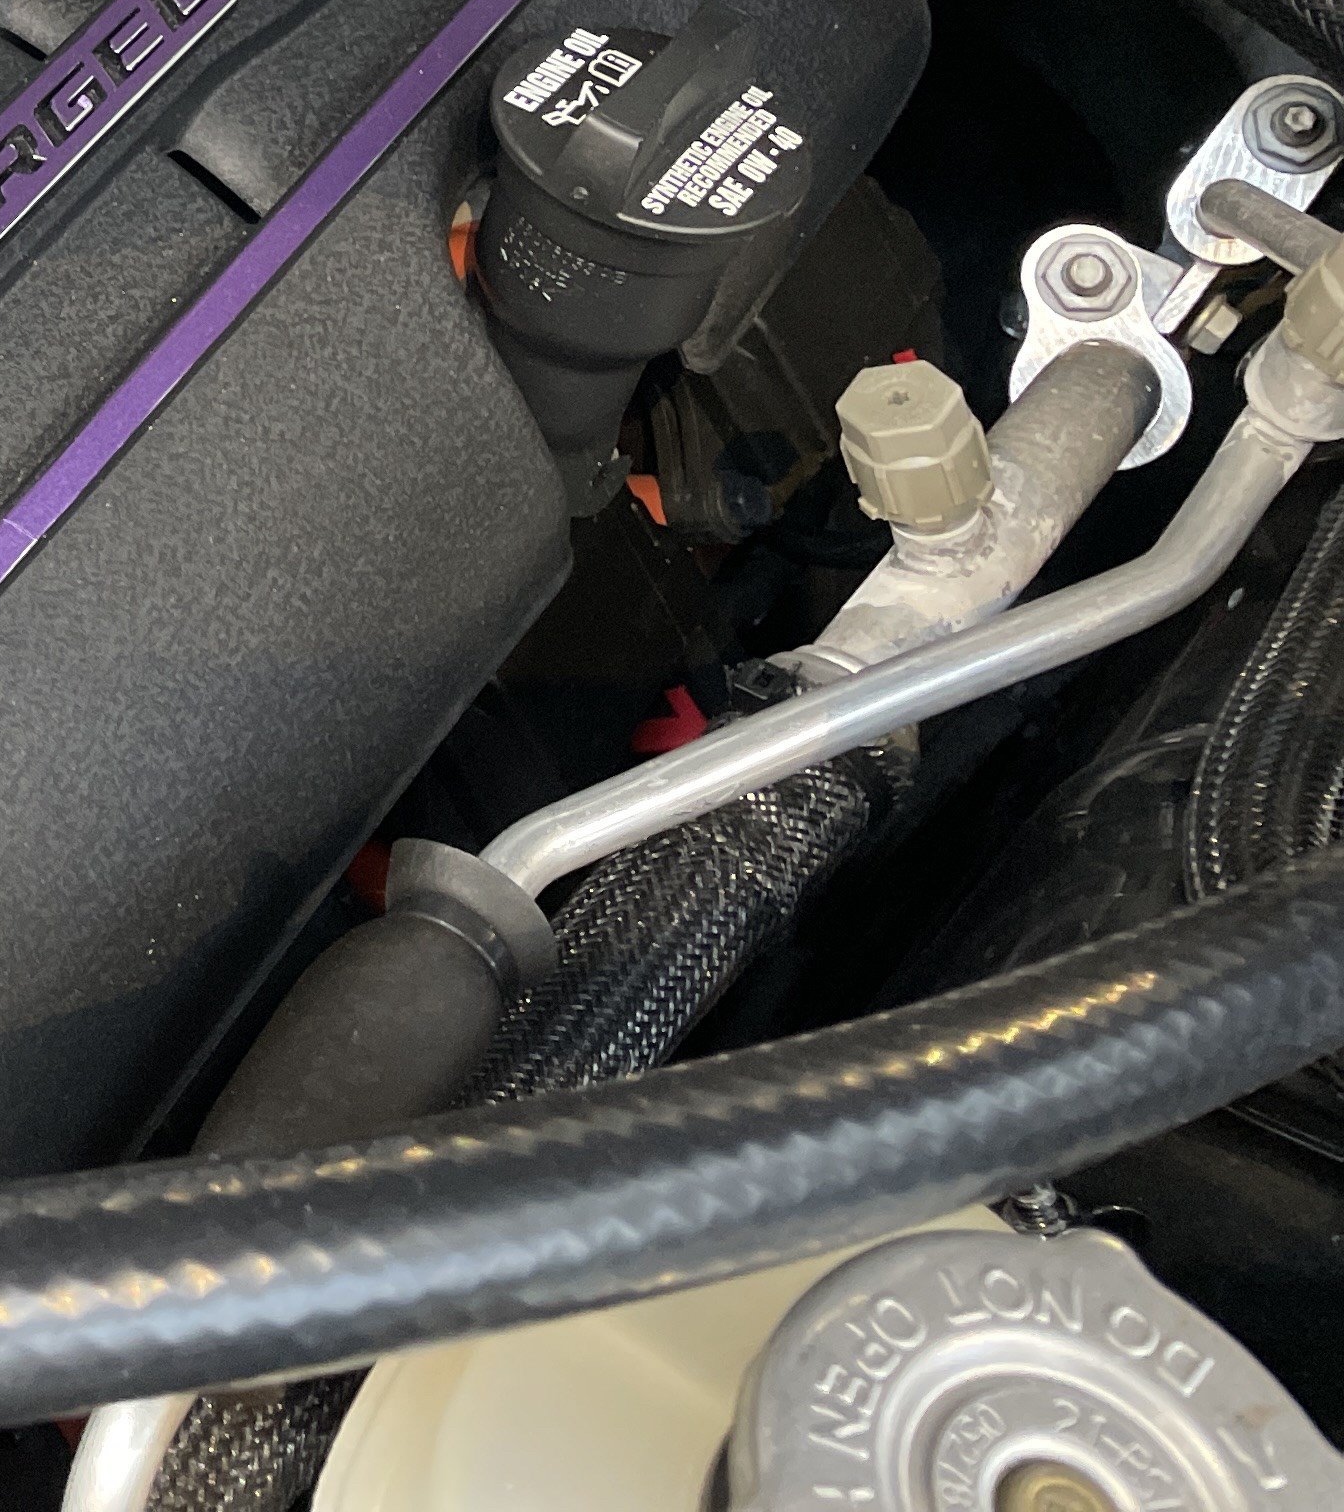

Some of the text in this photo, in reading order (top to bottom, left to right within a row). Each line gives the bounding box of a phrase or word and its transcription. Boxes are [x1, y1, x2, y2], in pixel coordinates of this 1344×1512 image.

[502, 27, 610, 113] ENGINE OIL
[640, 85, 774, 216] SYNTHETIC ENGINE OIL
[676, 108, 778, 208] RECOMMENDED
[708, 176, 754, 217] SAE
[808, 1266, 1216, 1460] DO NOT OPEN
